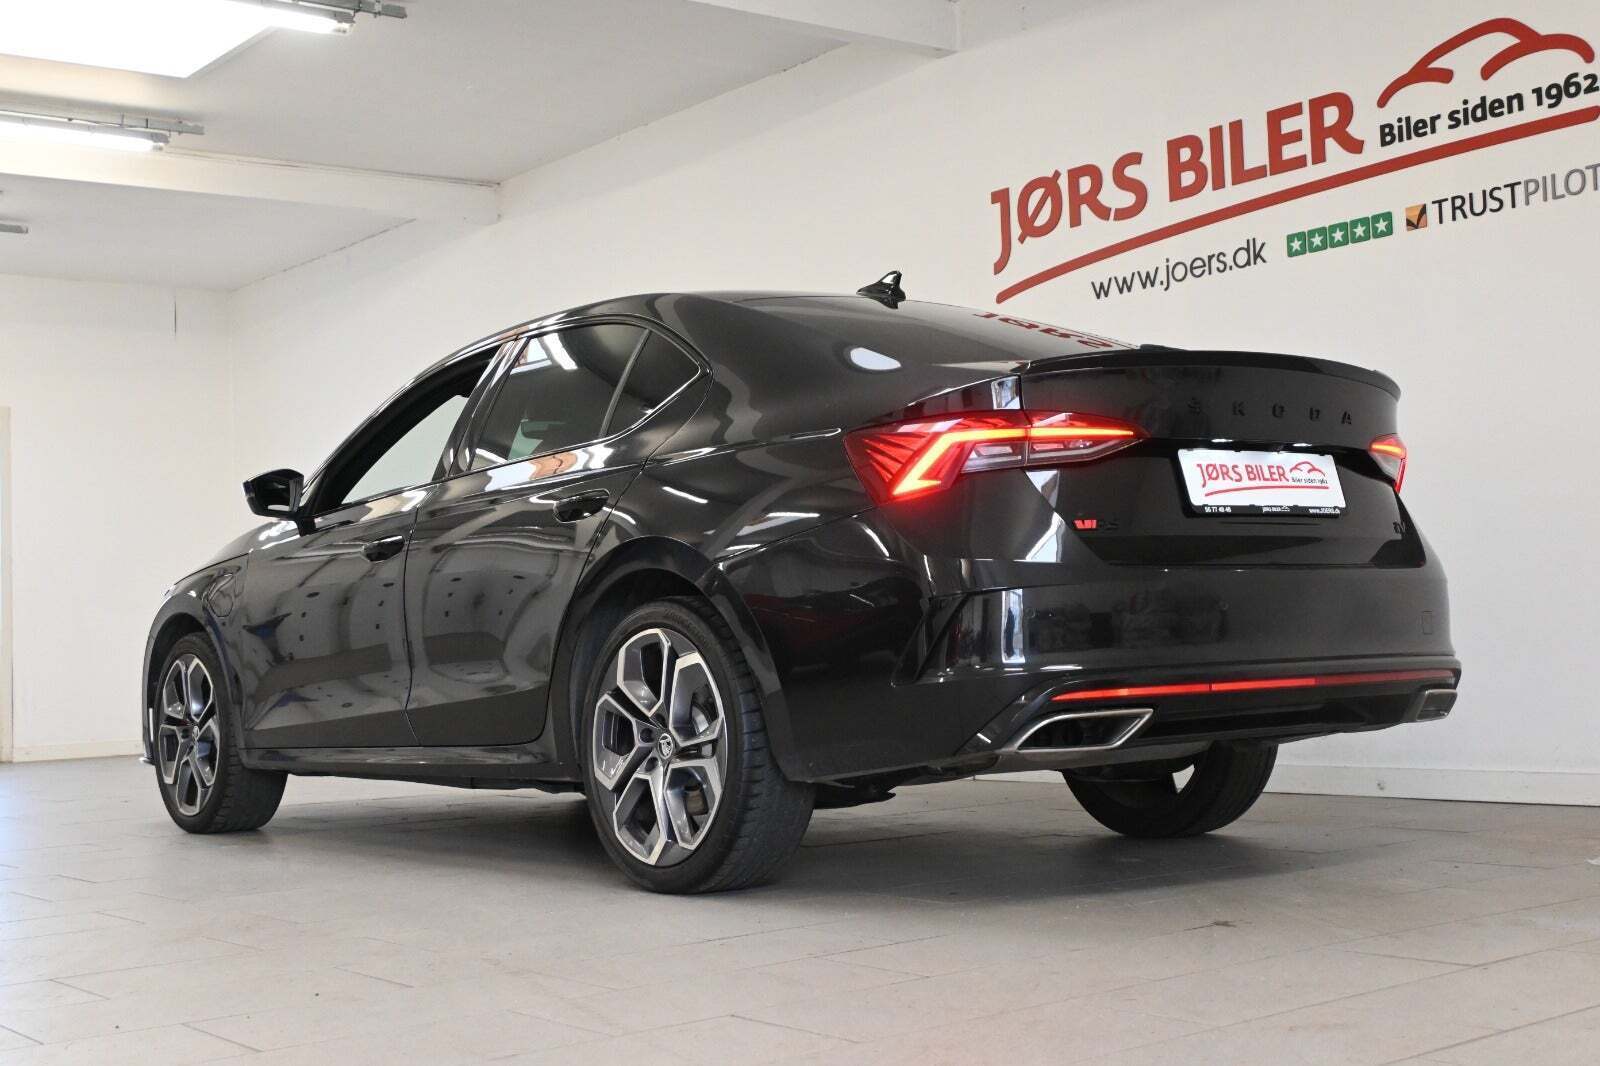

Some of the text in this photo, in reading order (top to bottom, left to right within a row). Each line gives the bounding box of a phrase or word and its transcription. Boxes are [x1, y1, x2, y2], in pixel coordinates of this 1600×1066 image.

[1379, 72, 1600, 148] Biler siden 1962
[990, 91, 1365, 275] JØRS BILER
[1432, 162, 1600, 225] TRUSTPILOT
[1090, 237, 1267, 300] www.joers.dk
[1196, 463, 1290, 488] JØRS BILER
